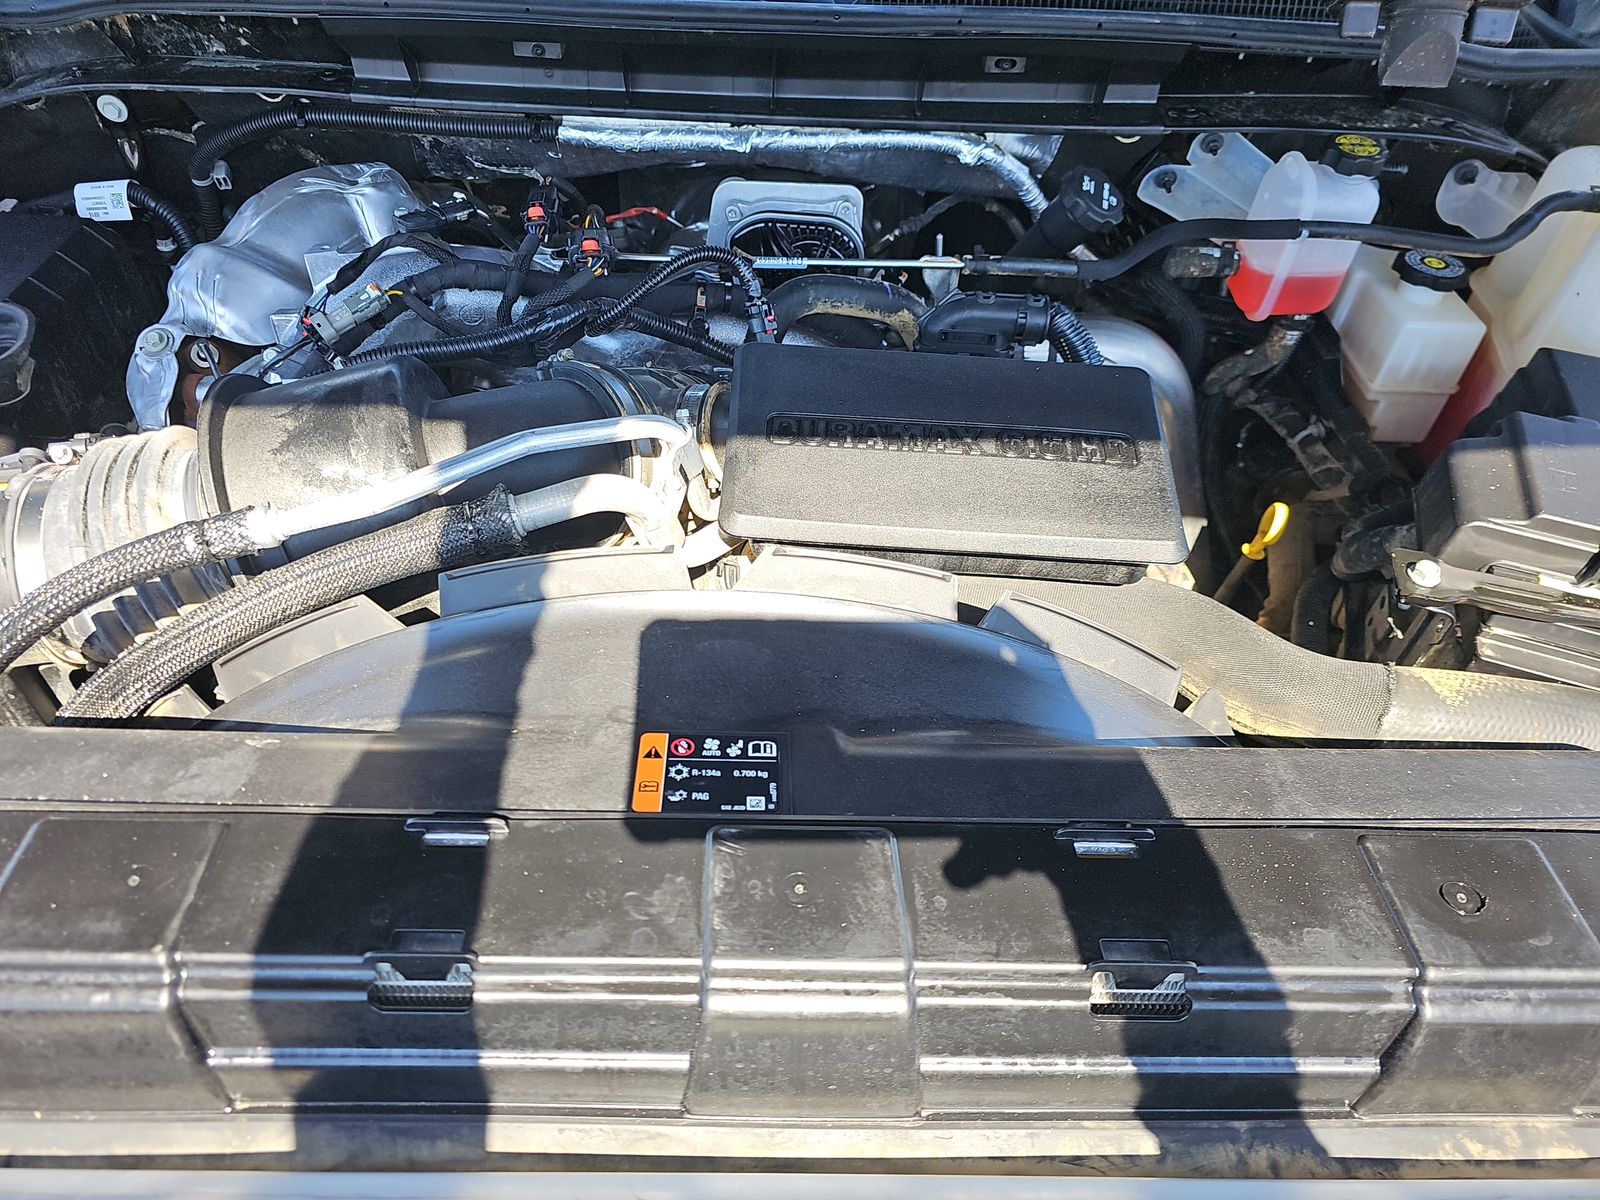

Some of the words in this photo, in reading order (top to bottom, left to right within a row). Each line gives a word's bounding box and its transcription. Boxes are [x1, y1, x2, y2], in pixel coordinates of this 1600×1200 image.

[772, 416, 987, 458] DURAMAX
[691, 768, 721, 777] R-134a
[733, 769, 756, 778] 0.700
[757, 769, 769, 779] kg
[691, 792, 710, 800] PAG
